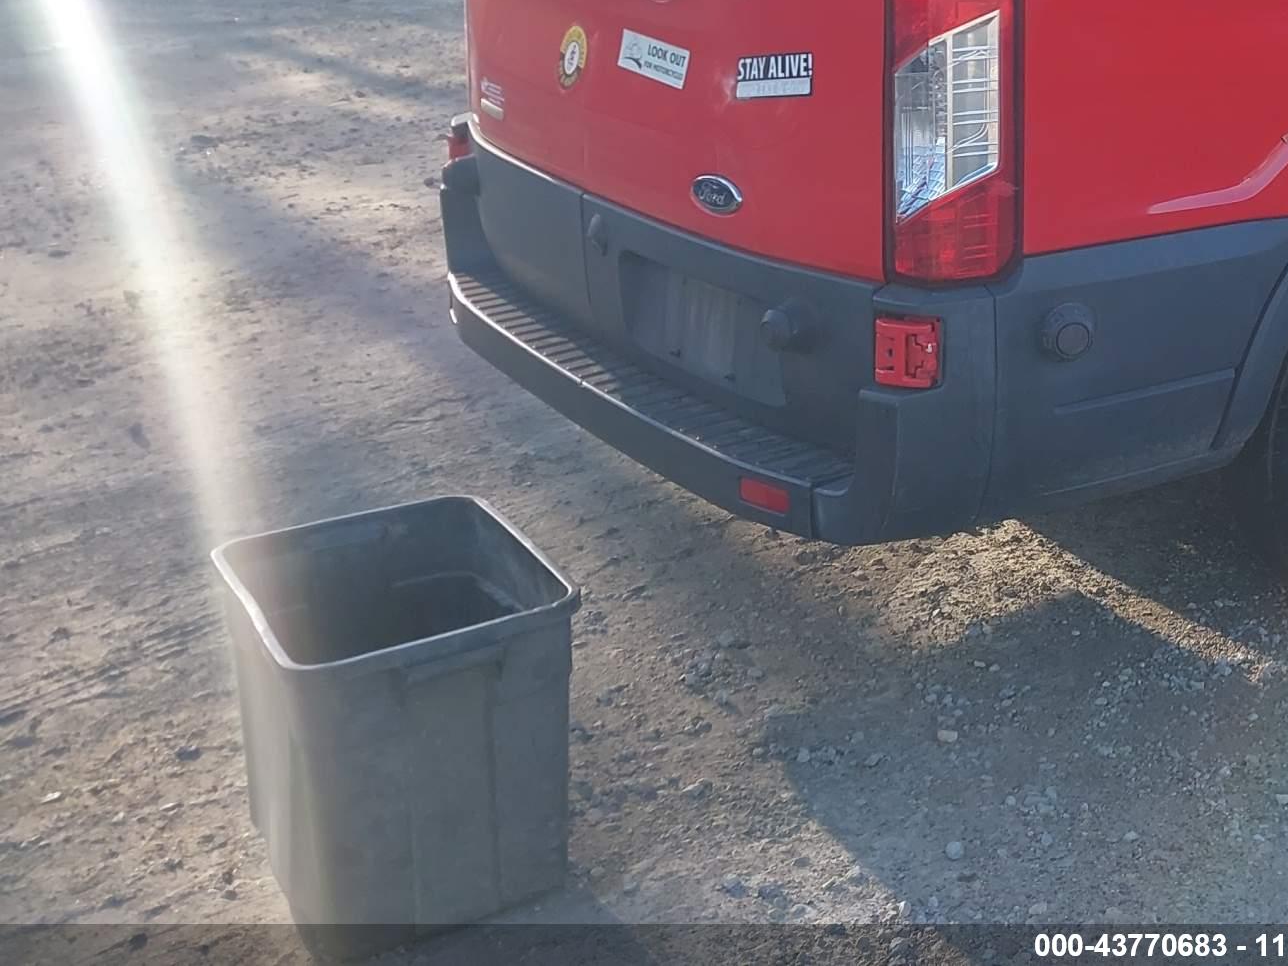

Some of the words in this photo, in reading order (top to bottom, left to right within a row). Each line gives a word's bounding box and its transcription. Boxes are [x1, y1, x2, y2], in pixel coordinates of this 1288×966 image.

[647, 44, 669, 61] LOOK
[669, 52, 687, 67] OUT
[737, 56, 766, 80] STAY
[767, 53, 813, 78] ALIVE!
